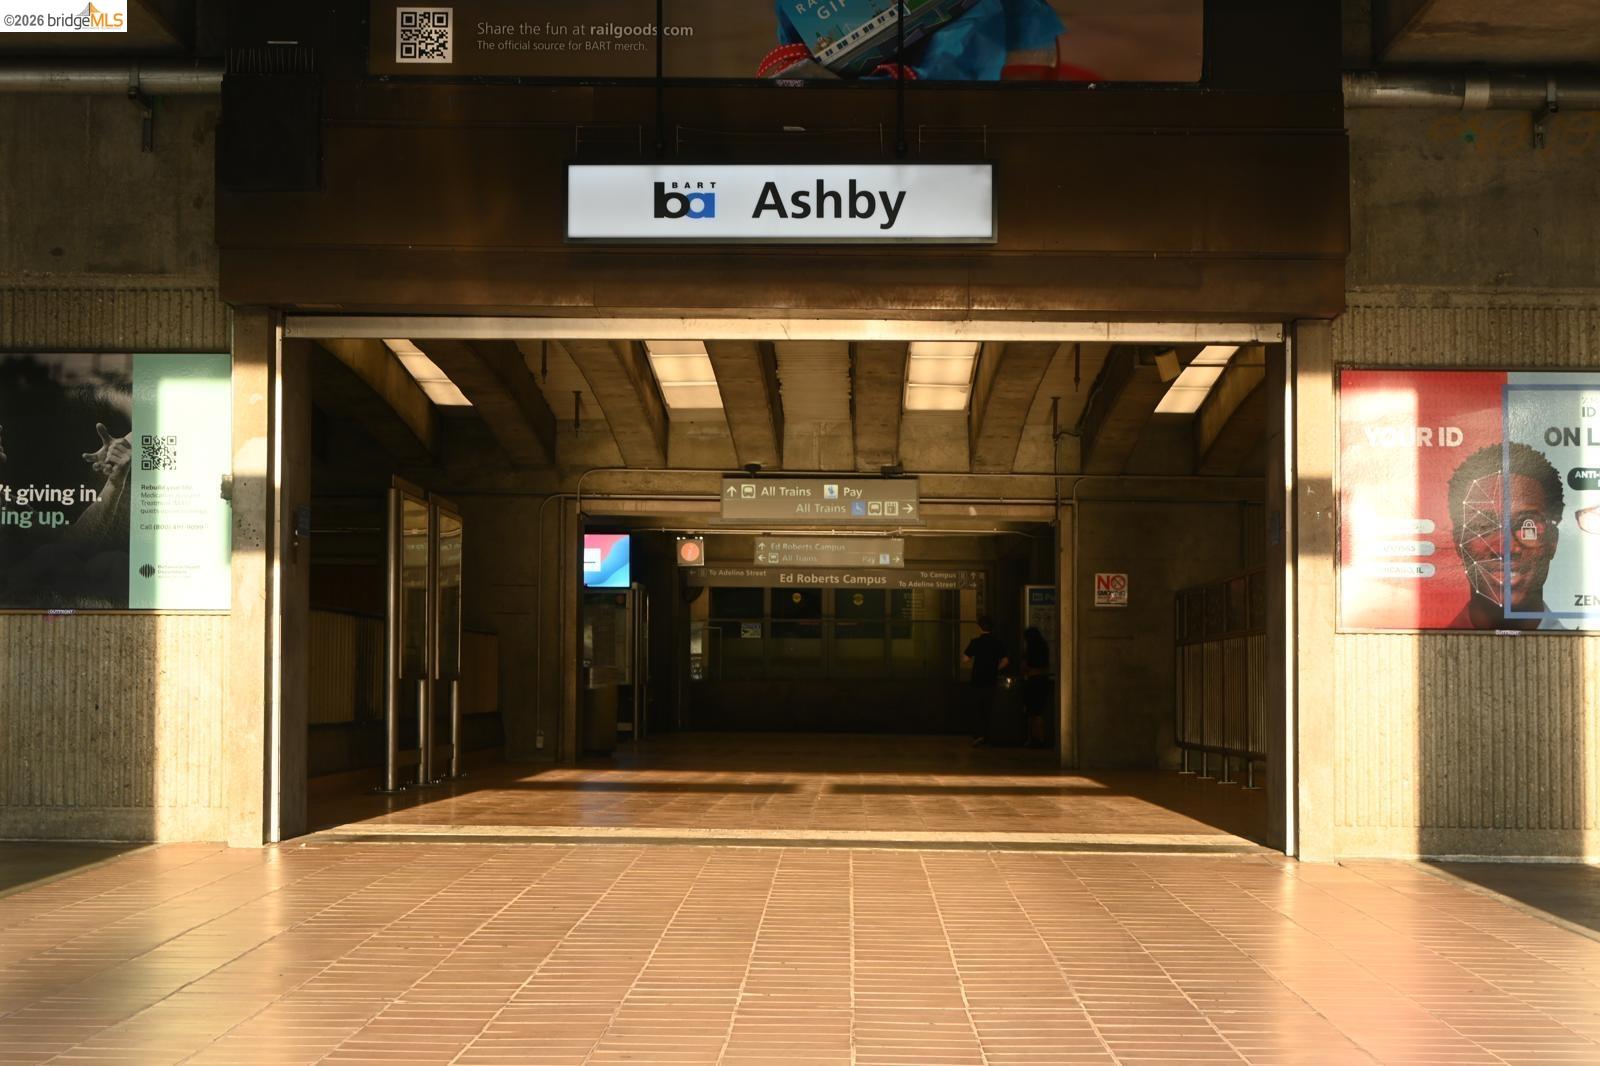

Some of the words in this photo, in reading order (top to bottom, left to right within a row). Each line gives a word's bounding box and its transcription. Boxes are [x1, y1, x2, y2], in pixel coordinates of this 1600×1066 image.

[477, 22, 514, 35] Share
[519, 22, 541, 35] the
[546, 22, 568, 35] fun
[572, 24, 586, 35] at
[590, 23, 694, 38] railgoodscom
[477, 40, 495, 51] The
[498, 40, 530, 51] official
[533, 42, 565, 51] source
[568, 40, 582, 51] for
[585, 41, 611, 51] BART
[614, 41, 648, 51] merch.
[672, 181, 717, 189] BART
[752, 179, 907, 229] Ashby
[1581, 406, 1597, 418] ID
[1438, 426, 1464, 447] ID
[1544, 426, 1581, 447] ON
[15, 484, 75, 505] giving
[80, 484, 102, 502] in.
[761, 487, 776, 497] All
[779, 487, 812, 497] Trains
[843, 487, 863, 500] Pay
[796, 504, 811, 513] All
[814, 503, 847, 513] Trains
[1, 506, 34, 529] ing
[38, 510, 70, 529] up.
[782, 543, 813, 551] Roberts
[815, 543, 846, 552] Campus
[862, 556, 875, 564] Pay
[746, 569, 767, 577] Street
[780, 573, 793, 583] Ed
[797, 573, 840, 584] Roberts
[843, 574, 887, 586] Campus
[930, 571, 956, 579] Campus
[1097, 575, 1126, 590] NO
